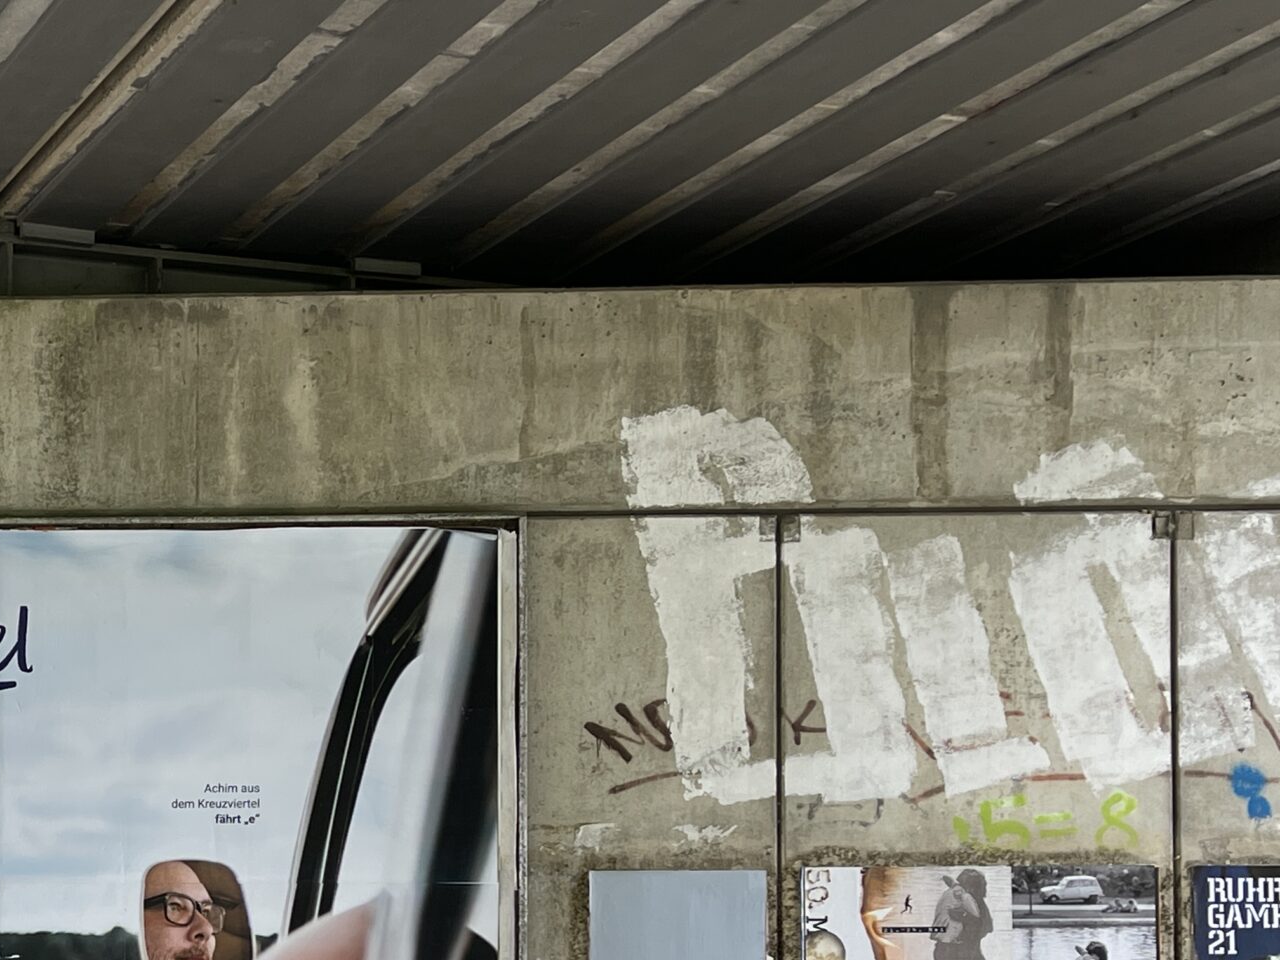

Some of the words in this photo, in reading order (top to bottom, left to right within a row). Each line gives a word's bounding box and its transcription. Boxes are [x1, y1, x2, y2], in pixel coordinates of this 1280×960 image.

[203, 783, 239, 794] Achim
[240, 784, 261, 794] aus
[170, 799, 196, 810] dem
[197, 799, 261, 810] Kreuzviertel
[215, 813, 242, 825] fährt
[1207, 929, 1238, 955] 21
